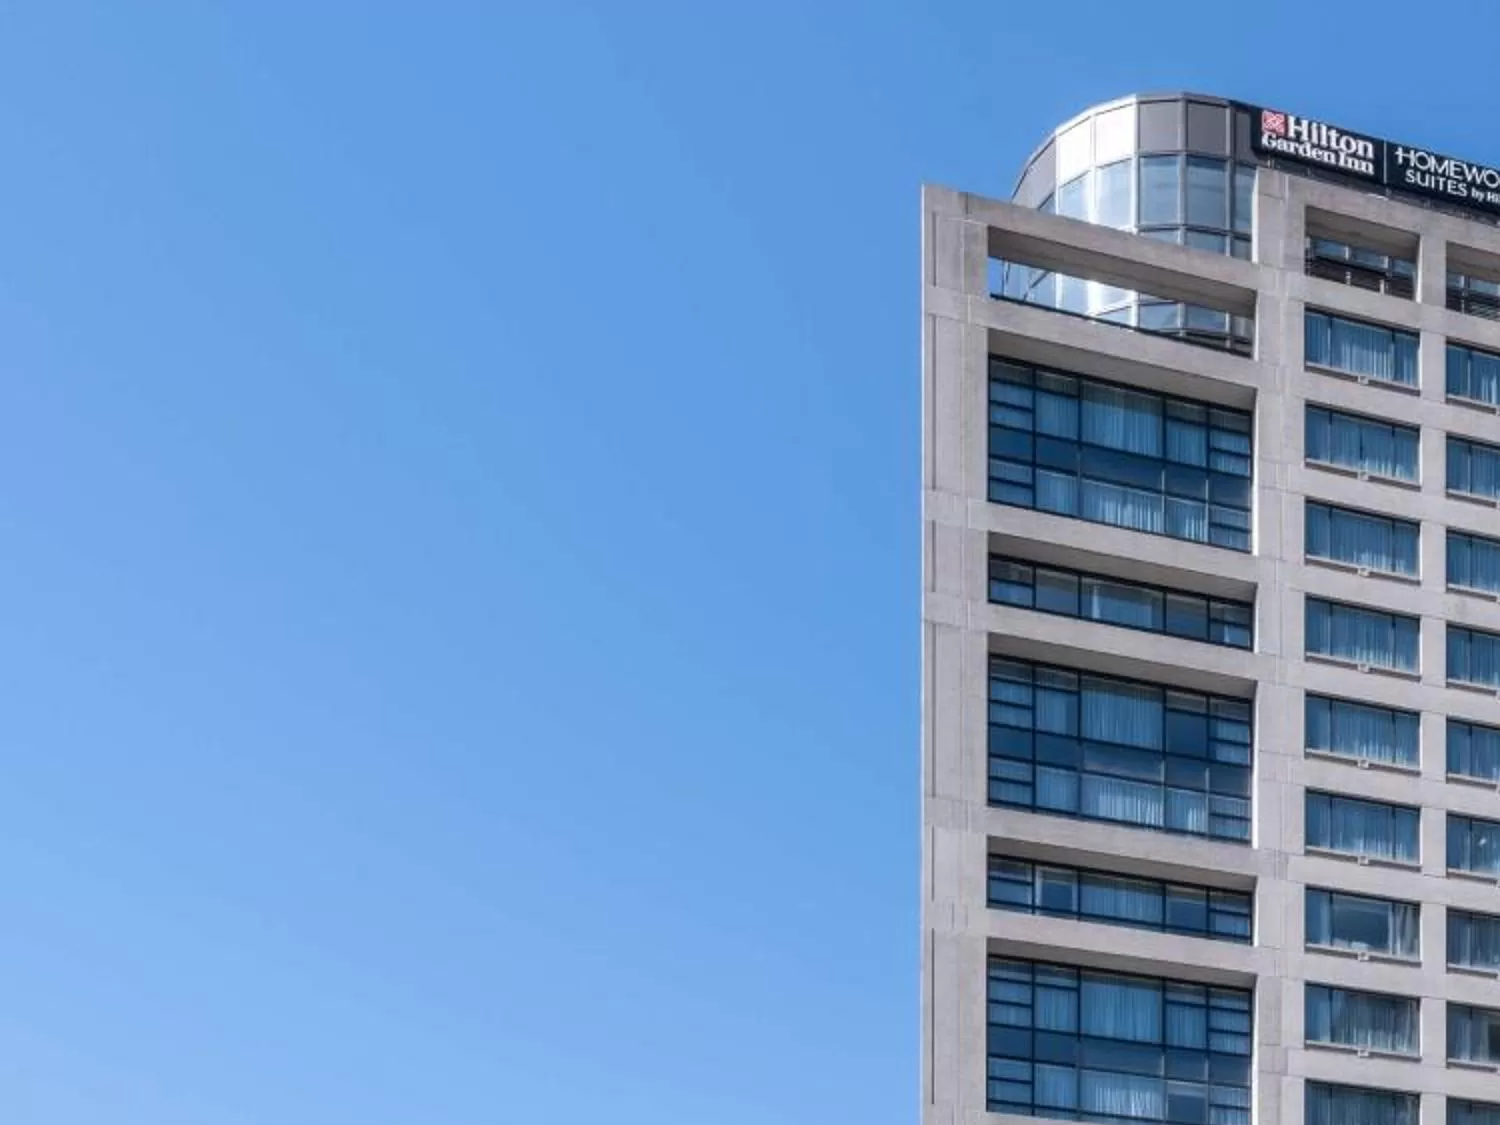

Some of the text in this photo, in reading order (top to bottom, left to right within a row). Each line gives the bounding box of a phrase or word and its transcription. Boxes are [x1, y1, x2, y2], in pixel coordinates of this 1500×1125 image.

[1261, 131, 1375, 175] Garden Inn
[1287, 115, 1374, 159] Hilton
[1405, 169, 1468, 197] SUITES
[1471, 187, 1485, 202] by
